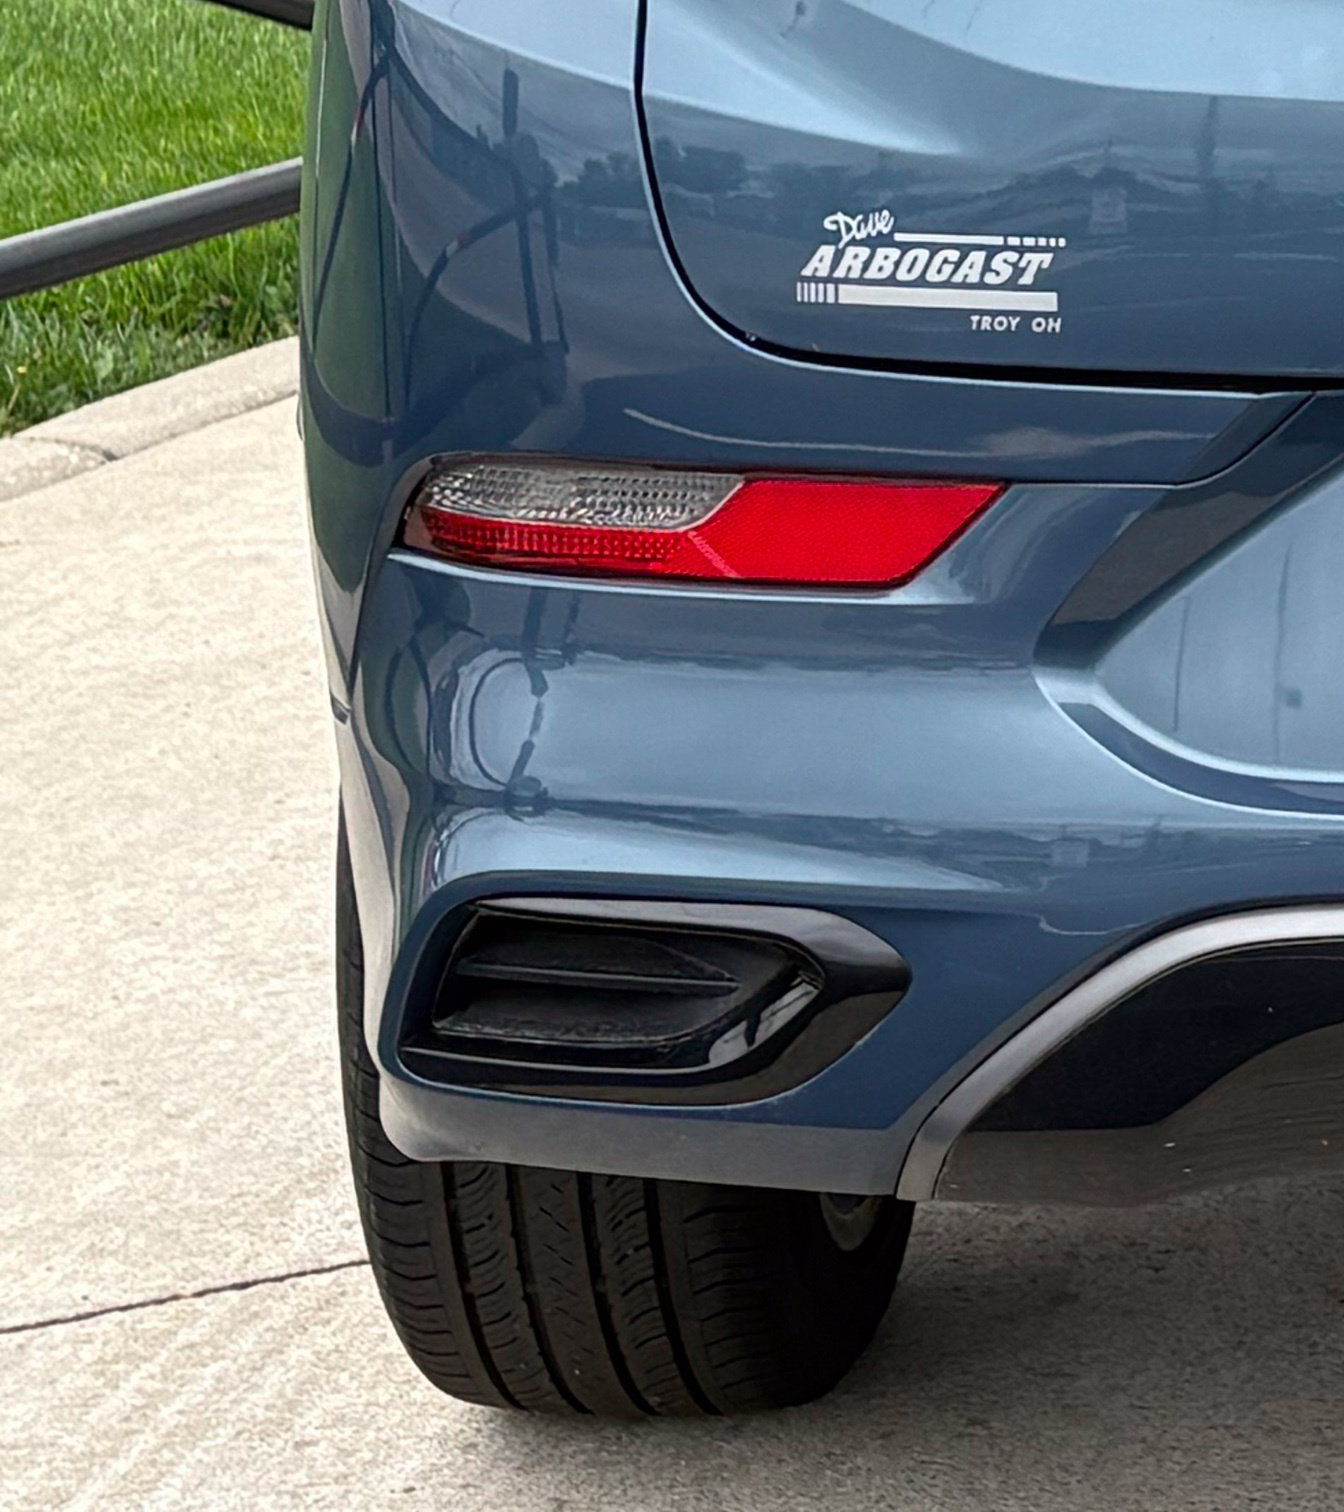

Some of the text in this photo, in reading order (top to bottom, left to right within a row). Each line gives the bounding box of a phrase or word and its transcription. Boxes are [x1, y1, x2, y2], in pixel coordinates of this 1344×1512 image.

[823, 209, 895, 250] Dave
[800, 244, 1055, 285] ARBOGAST
[970, 315, 1062, 333] TROY OH
